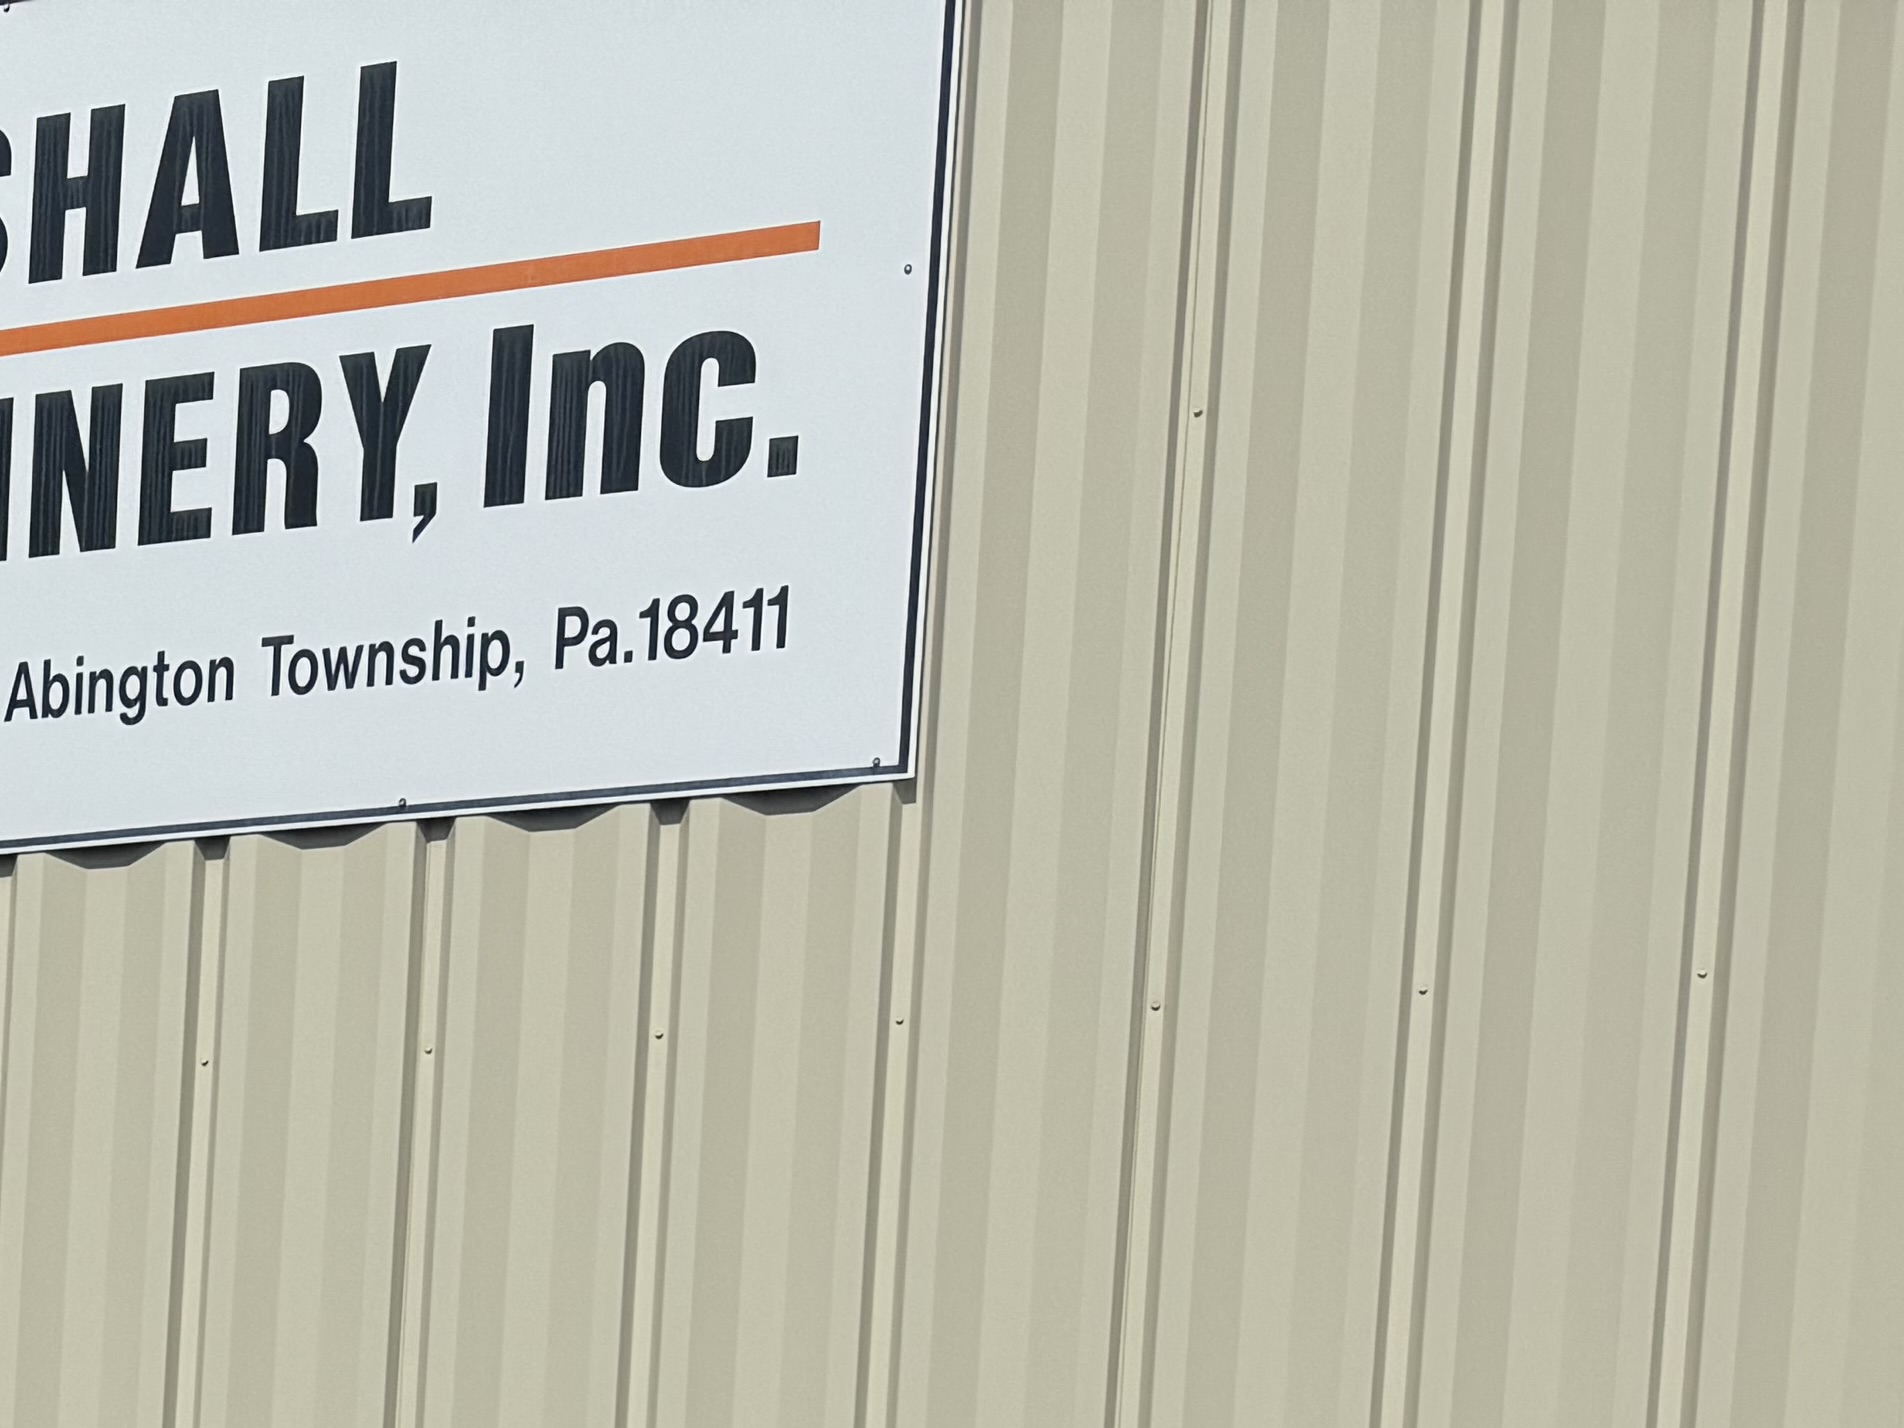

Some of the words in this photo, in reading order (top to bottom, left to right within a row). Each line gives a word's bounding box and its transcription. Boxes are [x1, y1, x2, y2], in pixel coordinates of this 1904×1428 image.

[483, 323, 799, 508] Inc.
[3, 650, 234, 726] Abington
[261, 616, 525, 697] Township,
